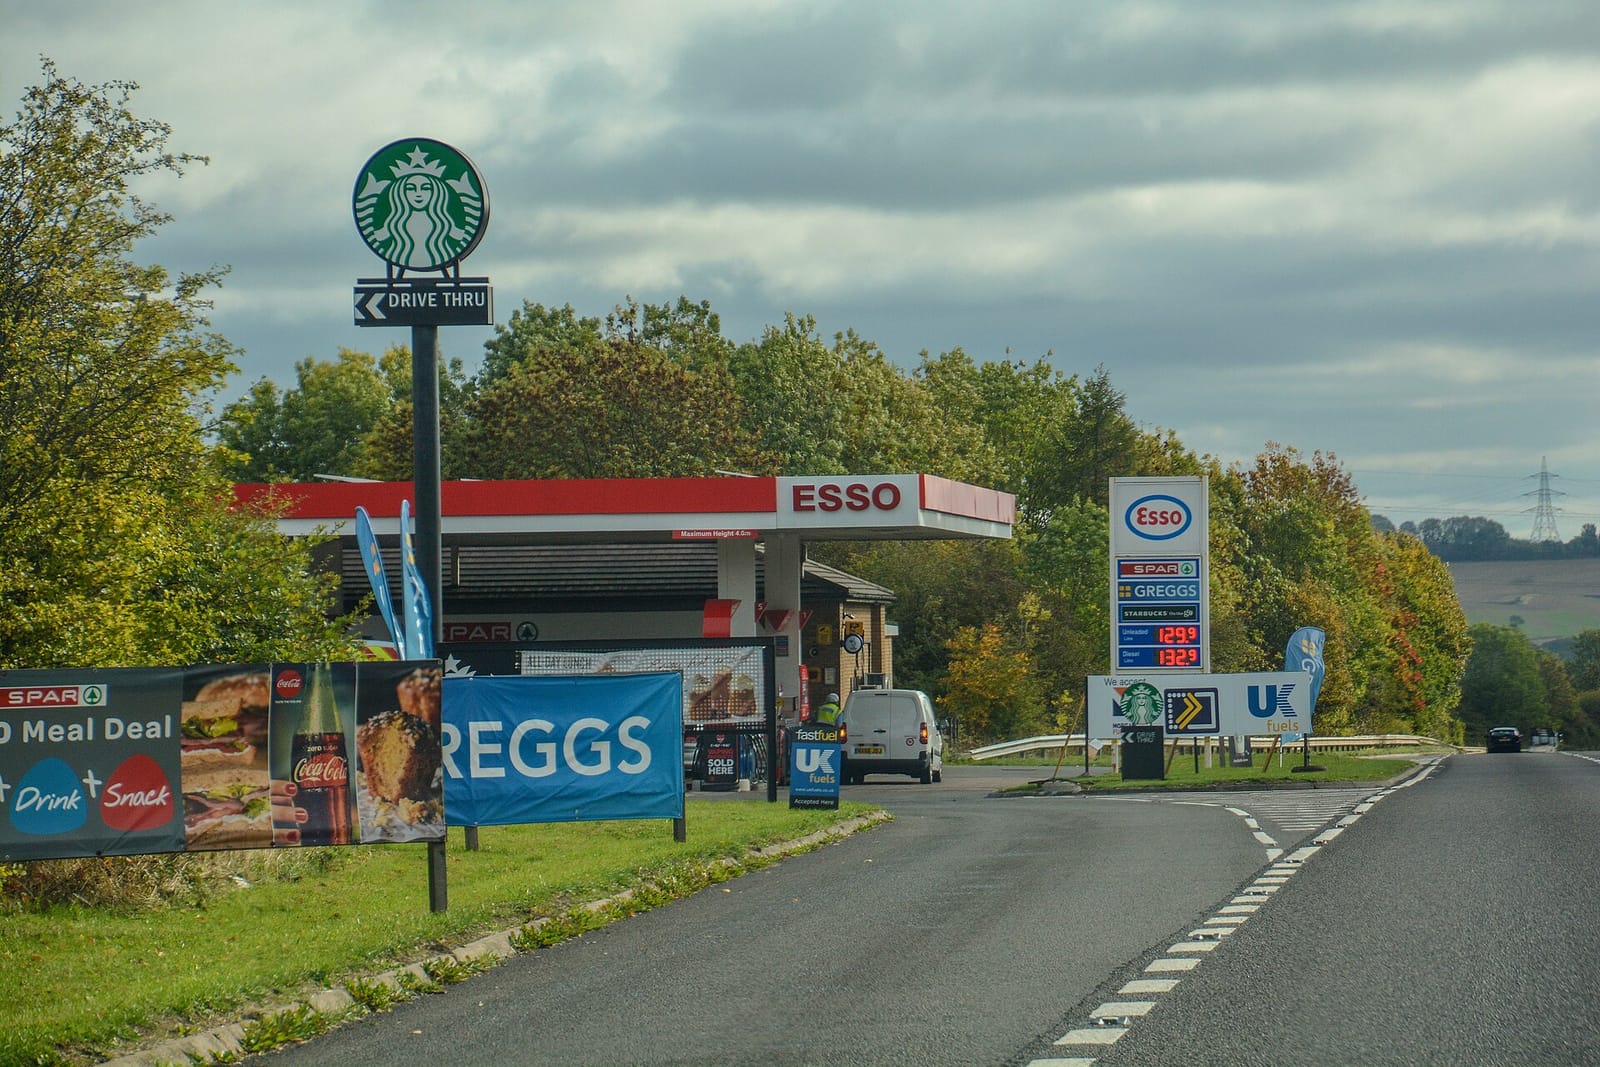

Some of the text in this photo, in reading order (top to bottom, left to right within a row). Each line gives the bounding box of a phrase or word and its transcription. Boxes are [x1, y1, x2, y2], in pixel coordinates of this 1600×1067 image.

[388, 291, 485, 308] DRIVE THRU
[792, 482, 901, 512] ESSO
[1136, 506, 1182, 526] Esso
[713, 530, 734, 538] Height
[1133, 564, 1178, 574] SPAR
[1134, 584, 1197, 598] GREGGS
[449, 625, 510, 640] PAR
[1103, 678, 1117, 686] We
[8, 689, 78, 704] SPAR
[1247, 683, 1298, 718] UK
[22, 717, 94, 743] Meal
[104, 714, 171, 740] Deal
[1266, 719, 1299, 732] fuels
[796, 728, 838, 741] fastfuel
[442, 716, 652, 779] REGGS
[707, 758, 734, 767] SOLD
[795, 748, 836, 774] UK
[708, 766, 734, 775] HERE
[809, 773, 836, 784] fuels
[15, 786, 82, 812] Drink
[103, 782, 170, 807] Snack
